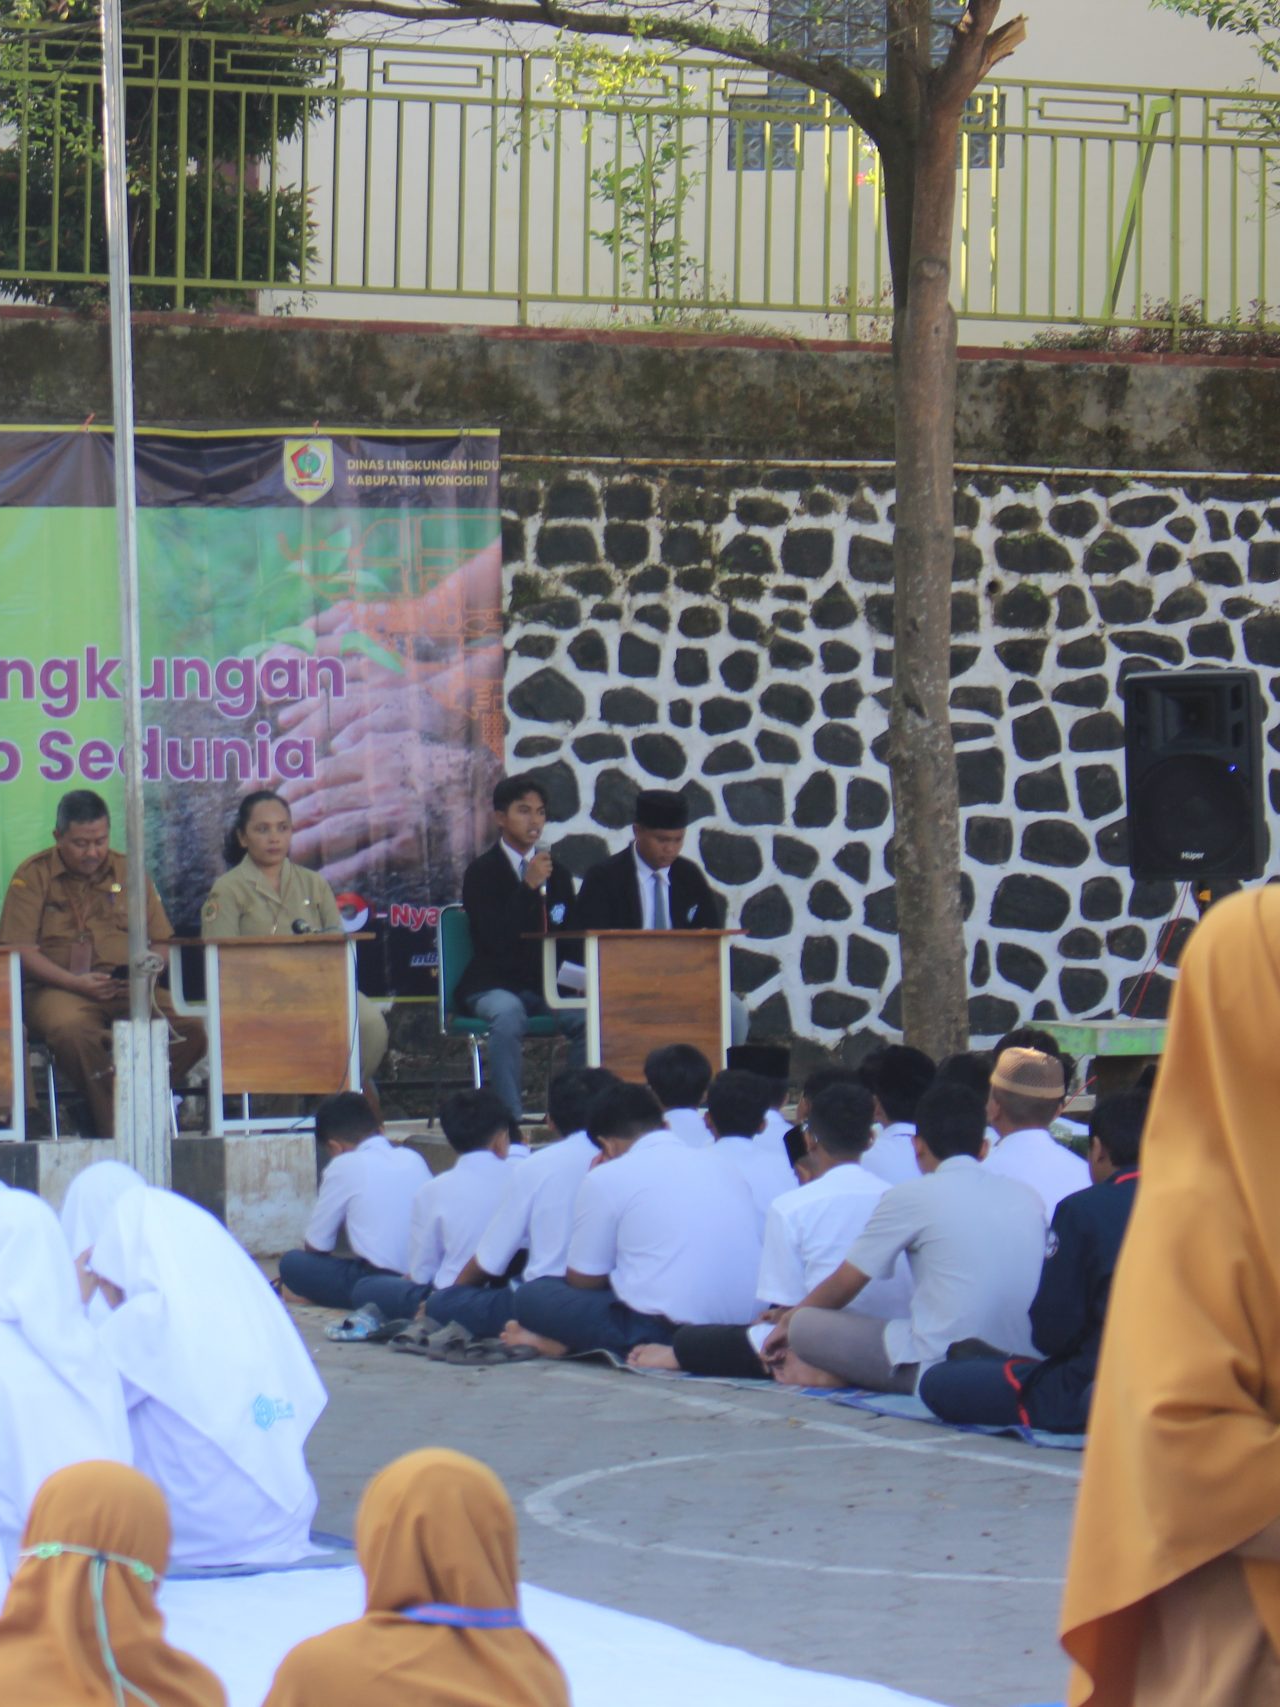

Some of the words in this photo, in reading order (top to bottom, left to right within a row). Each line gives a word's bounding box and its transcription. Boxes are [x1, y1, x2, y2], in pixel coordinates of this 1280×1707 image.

[347, 459, 385, 471] DINAS
[387, 459, 467, 471] LINGKUNGAN
[470, 459, 501, 471] HIDU
[347, 474, 420, 487] KABUPATEN
[423, 474, 488, 486] WONOGIRI
[38, 722, 317, 782] Sedunia
